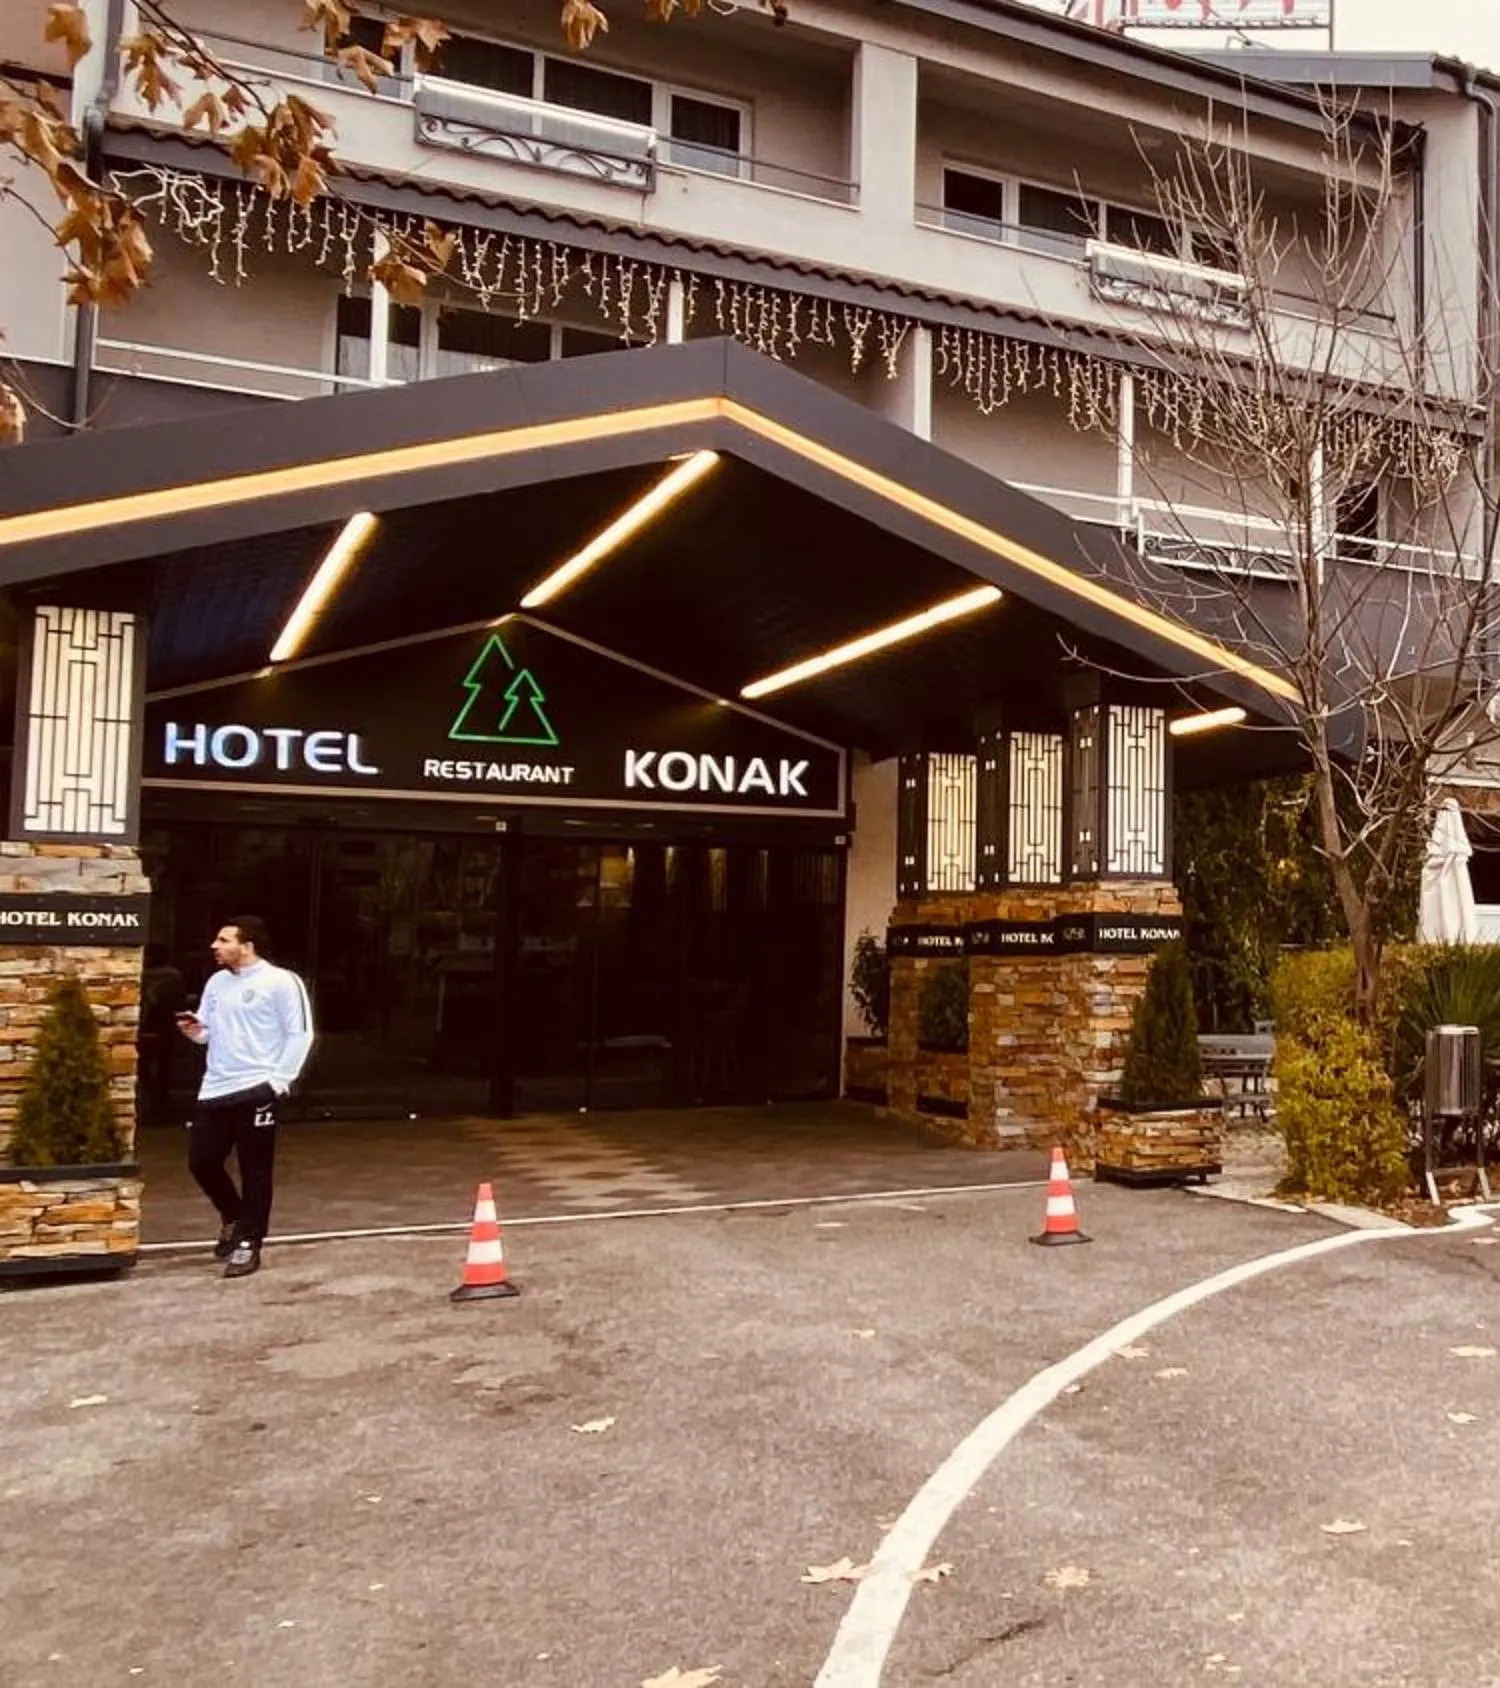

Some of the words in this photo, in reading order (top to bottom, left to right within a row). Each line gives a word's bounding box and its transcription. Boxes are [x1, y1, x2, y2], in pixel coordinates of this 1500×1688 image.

[164, 721, 380, 775] HOTEL
[624, 749, 810, 796] KONAK
[423, 758, 575, 785] RESTAURANT
[67, 911, 140, 927] KONAK
[1001, 932, 1038, 944] HOTEL
[1098, 927, 1138, 939] HOTEL
[917, 936, 952, 947] HOTEL
